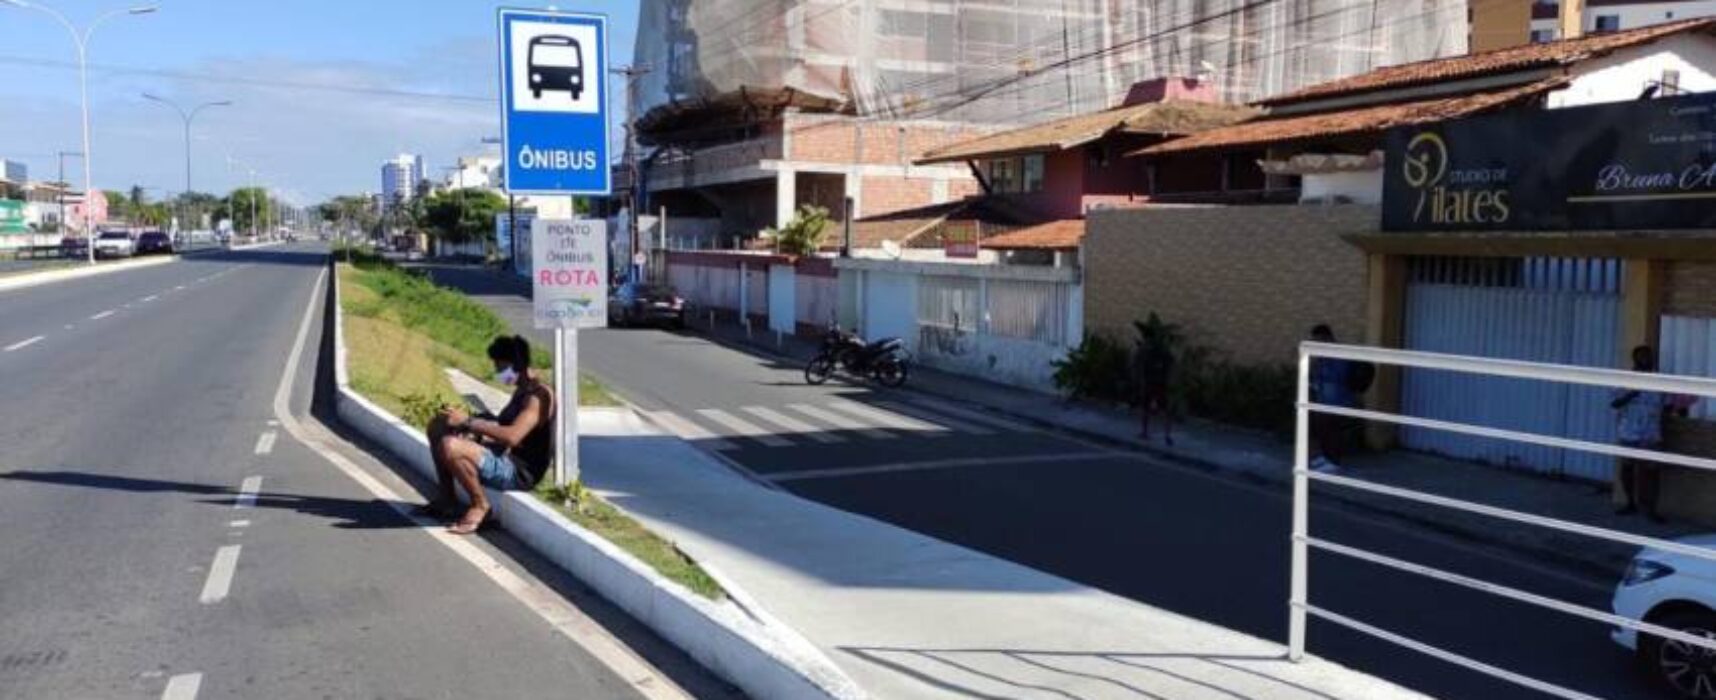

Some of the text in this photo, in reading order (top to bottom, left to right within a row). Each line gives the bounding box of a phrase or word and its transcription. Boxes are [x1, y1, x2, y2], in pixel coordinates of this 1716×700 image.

[517, 145, 597, 171] ÔNIBUS
[1450, 168, 1490, 184] STUDIO
[1595, 164, 1673, 191] Bruna
[547, 224, 591, 236] PONTO
[546, 249, 594, 263] ÔNIBUS
[539, 269, 599, 286] ROTA
